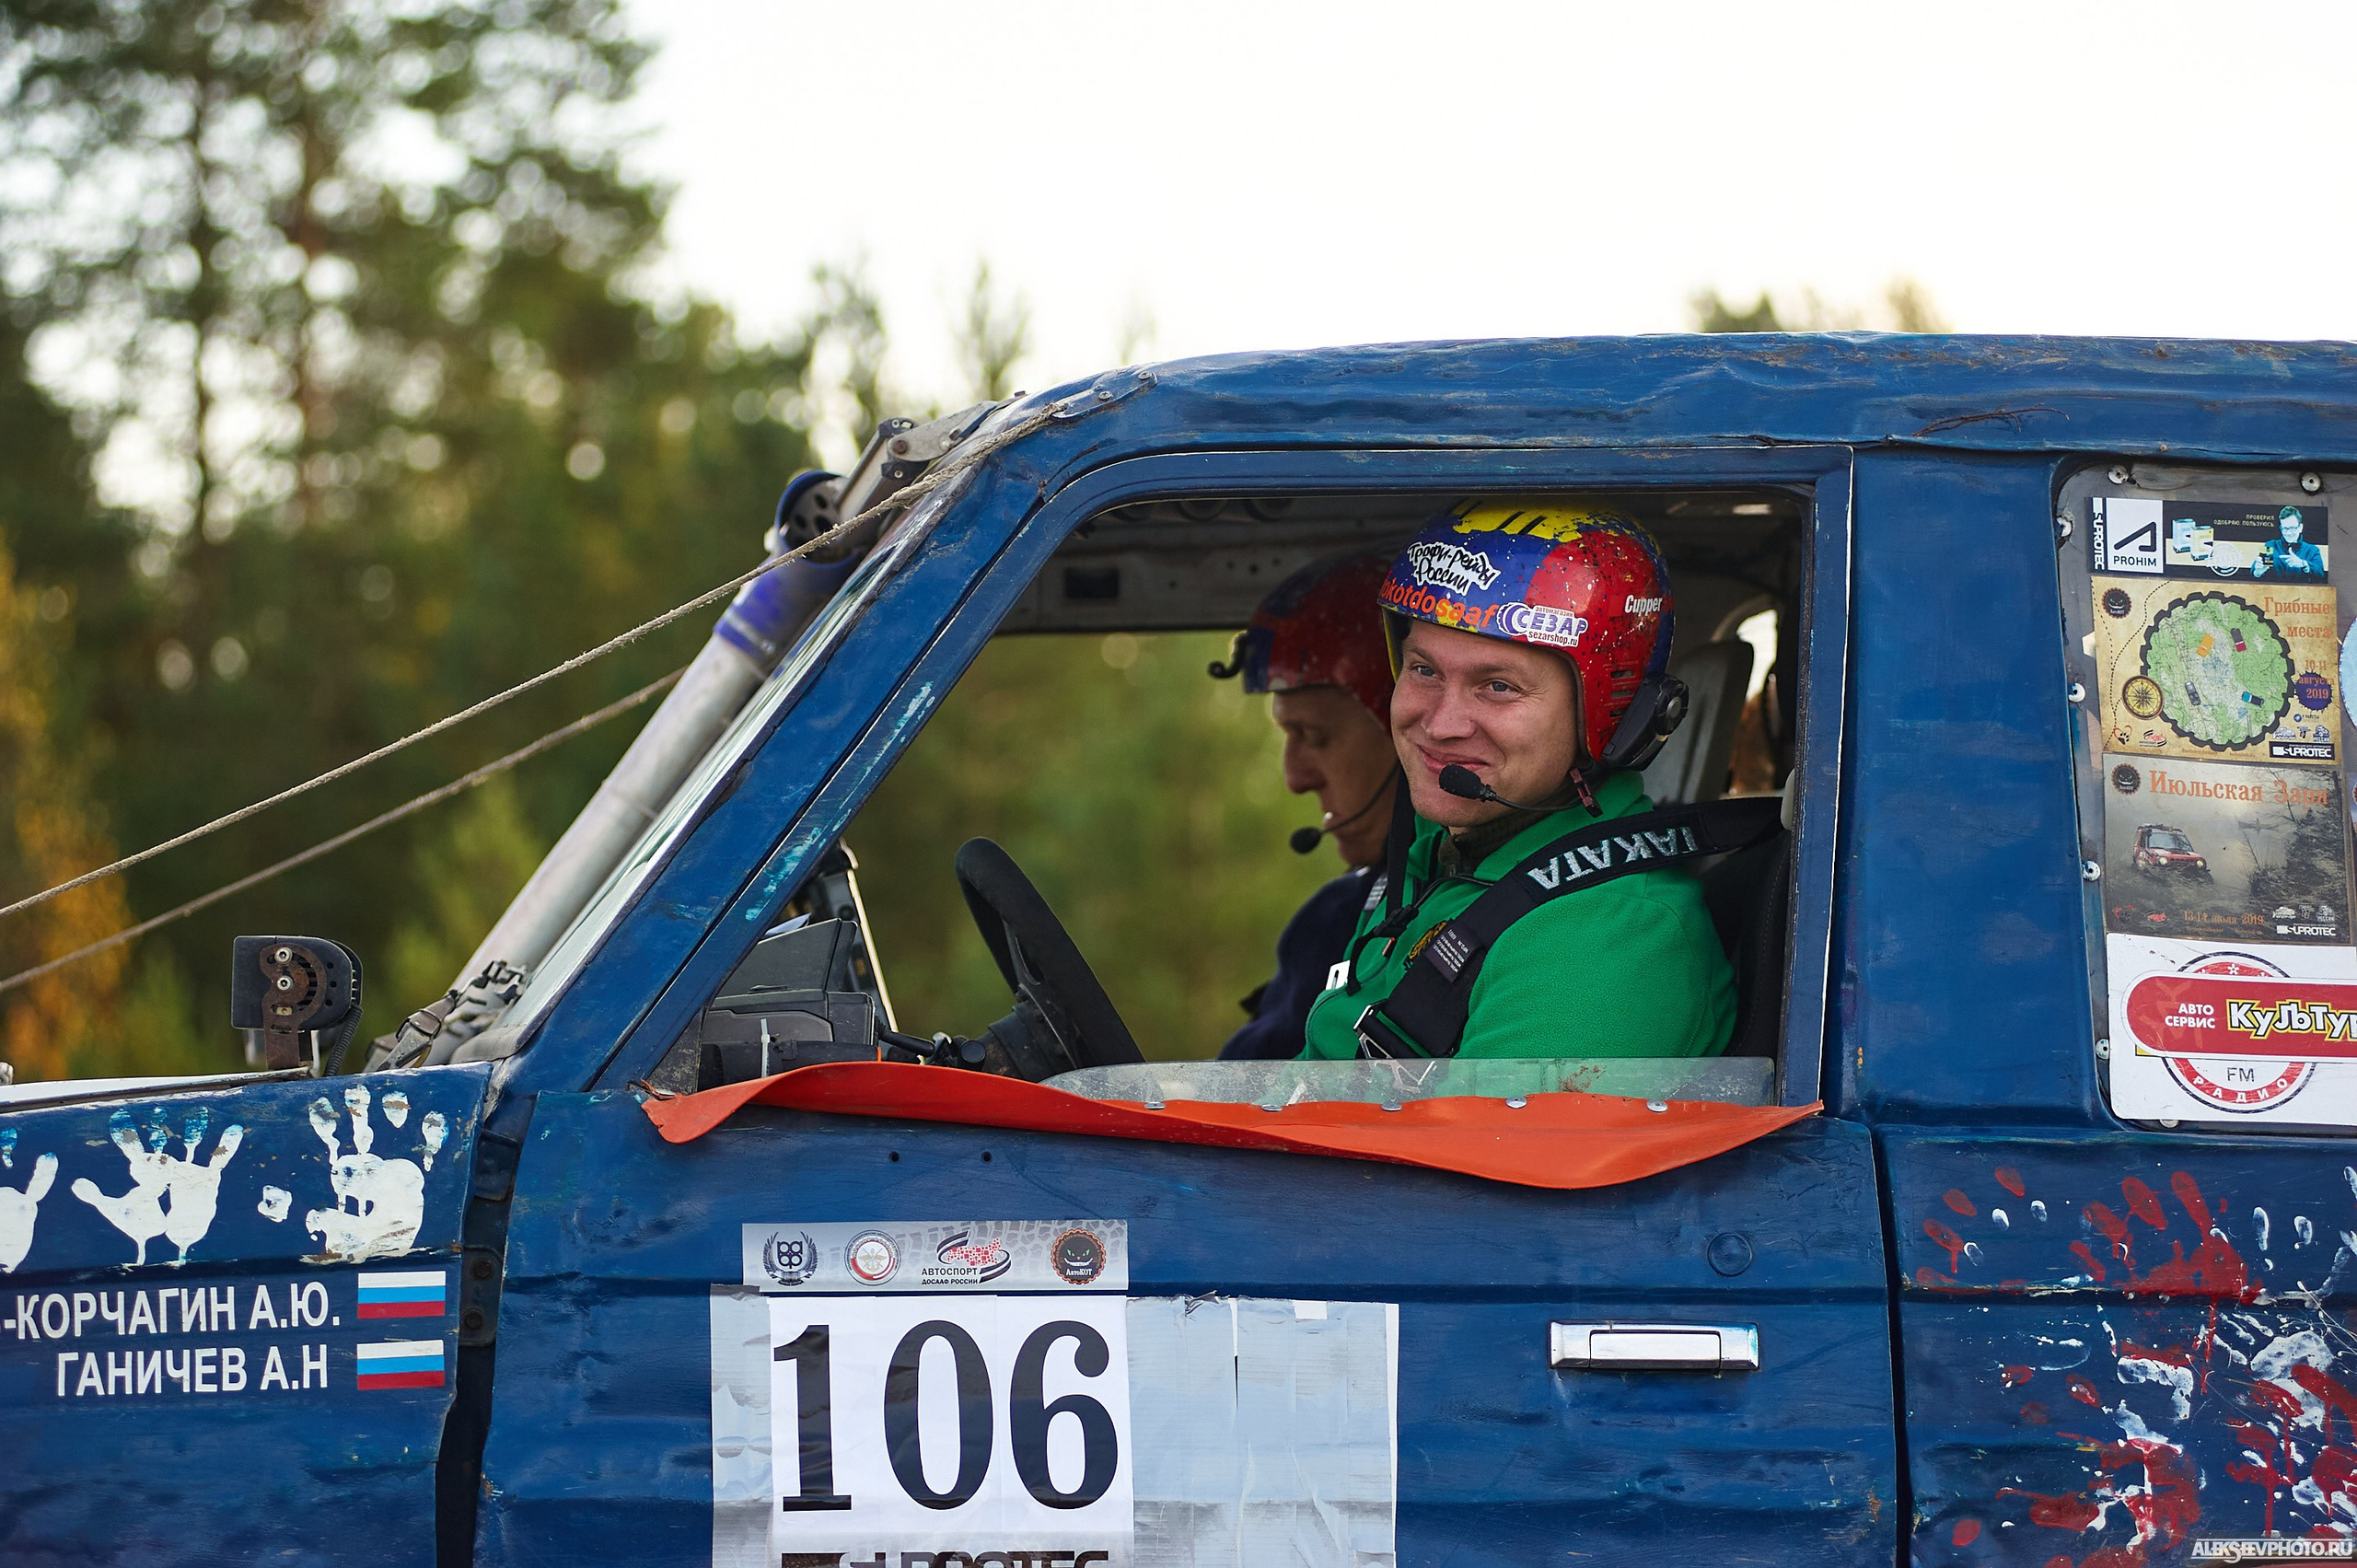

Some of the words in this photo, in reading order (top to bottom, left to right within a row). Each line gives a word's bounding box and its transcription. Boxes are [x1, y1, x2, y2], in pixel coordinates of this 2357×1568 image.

[2093, 512, 2105, 570] SUPROTEC
[2113, 555, 2157, 567] PROHIM
[1624, 594, 1663, 617] Cupper
[2264, 597, 2331, 617] Грибные
[1516, 610, 1587, 637] СЕЗАР
[1528, 631, 1578, 647] sezarshop.ru
[2287, 626, 2331, 639] места
[2305, 659, 2328, 671] 10-11
[2298, 675, 2335, 687] августа
[2305, 688, 2329, 699] 2019
[2283, 747, 2332, 758] SUPROTEC
[2149, 770, 2264, 802] Июльская
[2274, 779, 2328, 809] Заря
[1527, 826, 1699, 892] TAKATA
[2241, 912, 2265, 925] 2019
[2288, 925, 2337, 936] SUPROTEC
[2177, 1003, 2214, 1016] АВТО
[2165, 1015, 2215, 1029] СЕРВИС
[2226, 1067, 2255, 1083] FM
[2193, 1076, 2288, 1103] РАДИО
[921, 1267, 979, 1276] АВТОСПОРТ
[249, 1281, 342, 1330] А.Ю.
[57, 1347, 247, 1397] ГАНИЧЕВ
[260, 1344, 329, 1390] А.Н
[773, 1318, 1119, 1512] 106
